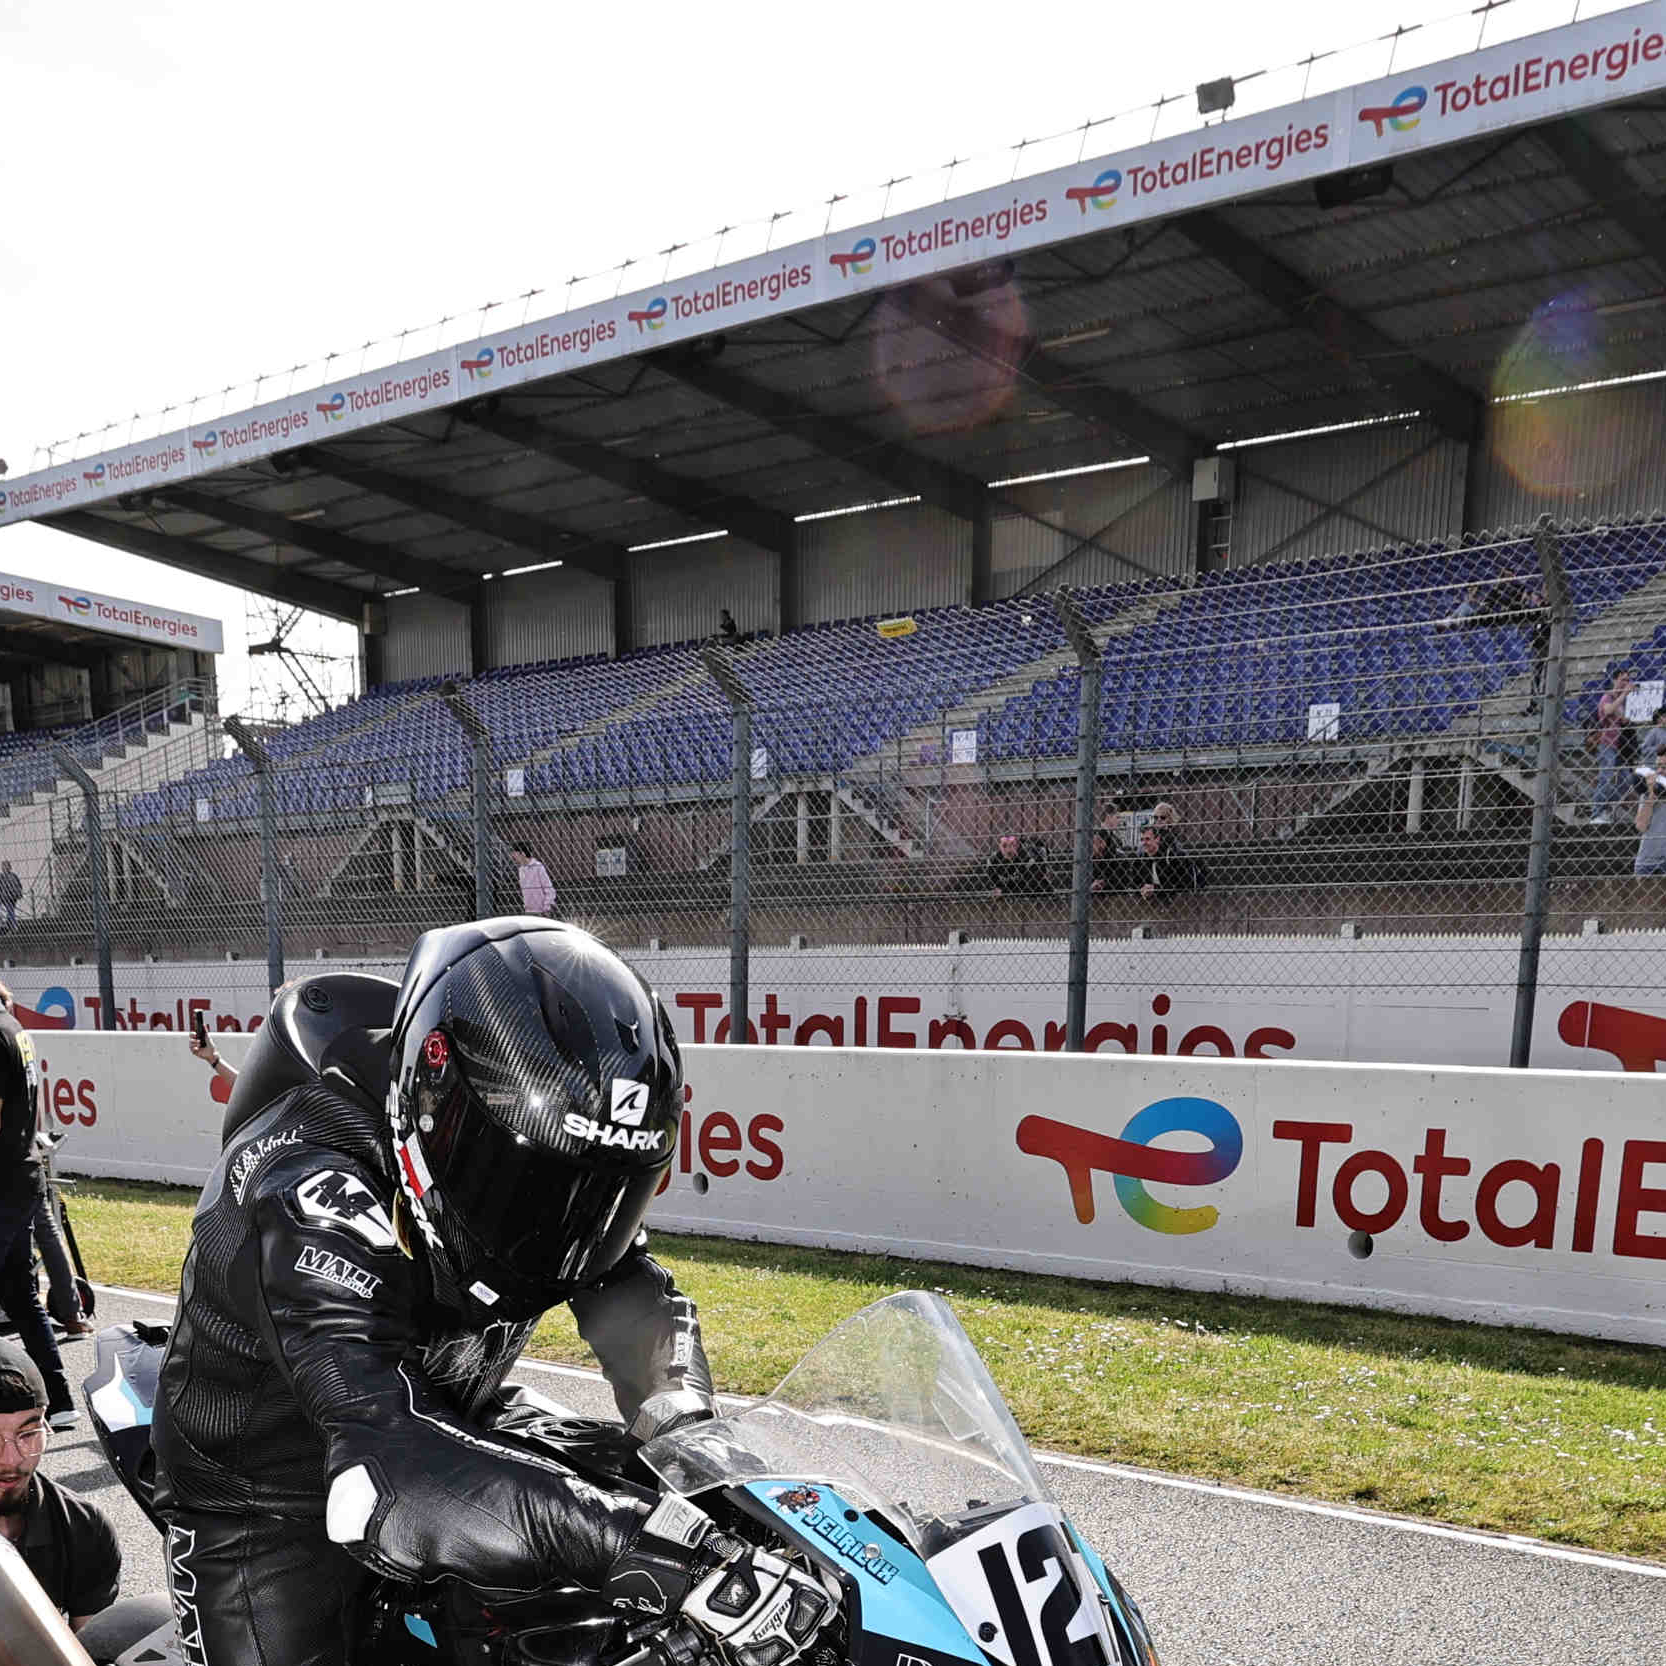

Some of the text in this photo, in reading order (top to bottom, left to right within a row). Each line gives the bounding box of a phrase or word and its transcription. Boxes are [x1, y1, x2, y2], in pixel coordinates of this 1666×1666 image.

[1127, 122, 1329, 198] TotalEnergies
[881, 201, 1047, 261] TotalEnergies
[671, 262, 813, 317] TotalEnergies
[496, 317, 616, 369] TotalEnergies
[346, 368, 450, 412] TotalEnergies
[219, 412, 309, 450] TotalEnergies
[107, 446, 186, 482] TotalEnergies
[8, 475, 78, 507] TotalEnergies
[94, 602, 198, 637] TotalEnergies
[562, 1113, 665, 1150] SHARK
